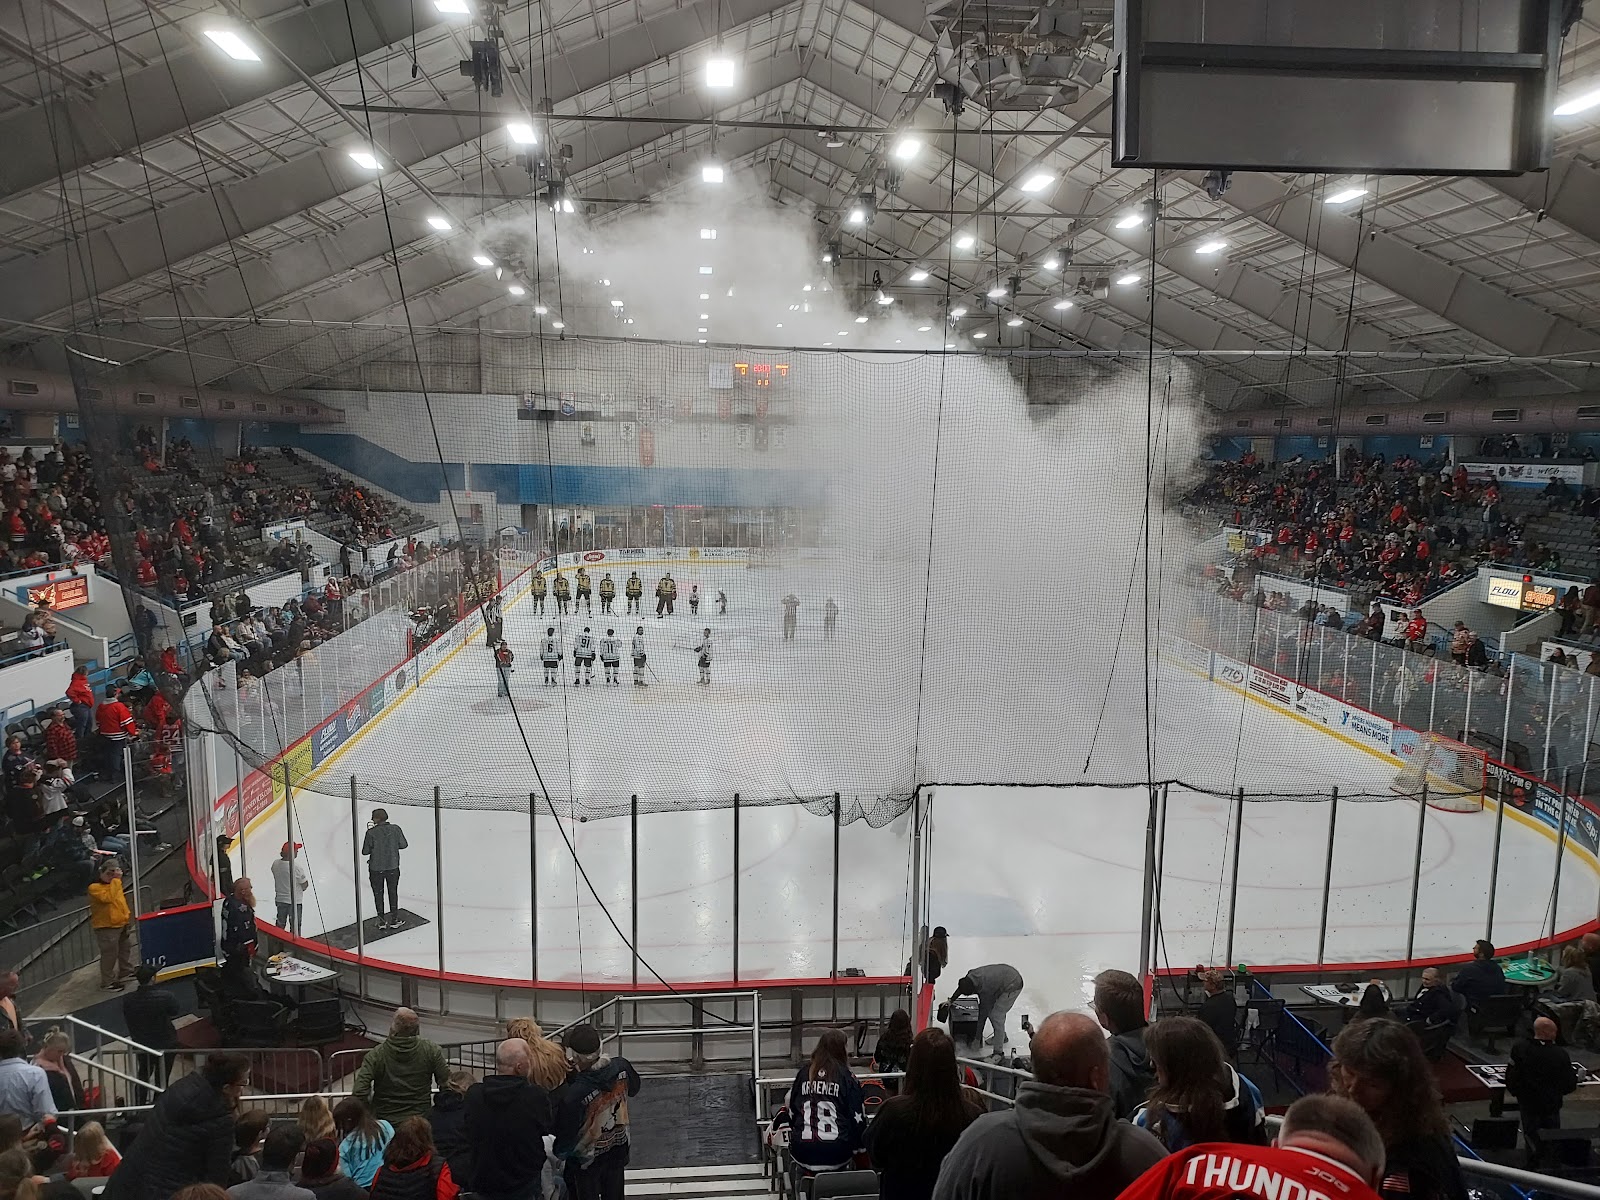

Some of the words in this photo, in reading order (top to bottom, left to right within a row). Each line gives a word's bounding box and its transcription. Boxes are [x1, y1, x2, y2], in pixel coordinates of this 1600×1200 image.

[1492, 586, 1519, 596] FLOW
[162, 729, 182, 745] 24
[1351, 721, 1372, 737] MEANS
[1371, 728, 1390, 745] MORE
[801, 1100, 839, 1141] 18
[1186, 1153, 1333, 1200] THUND
